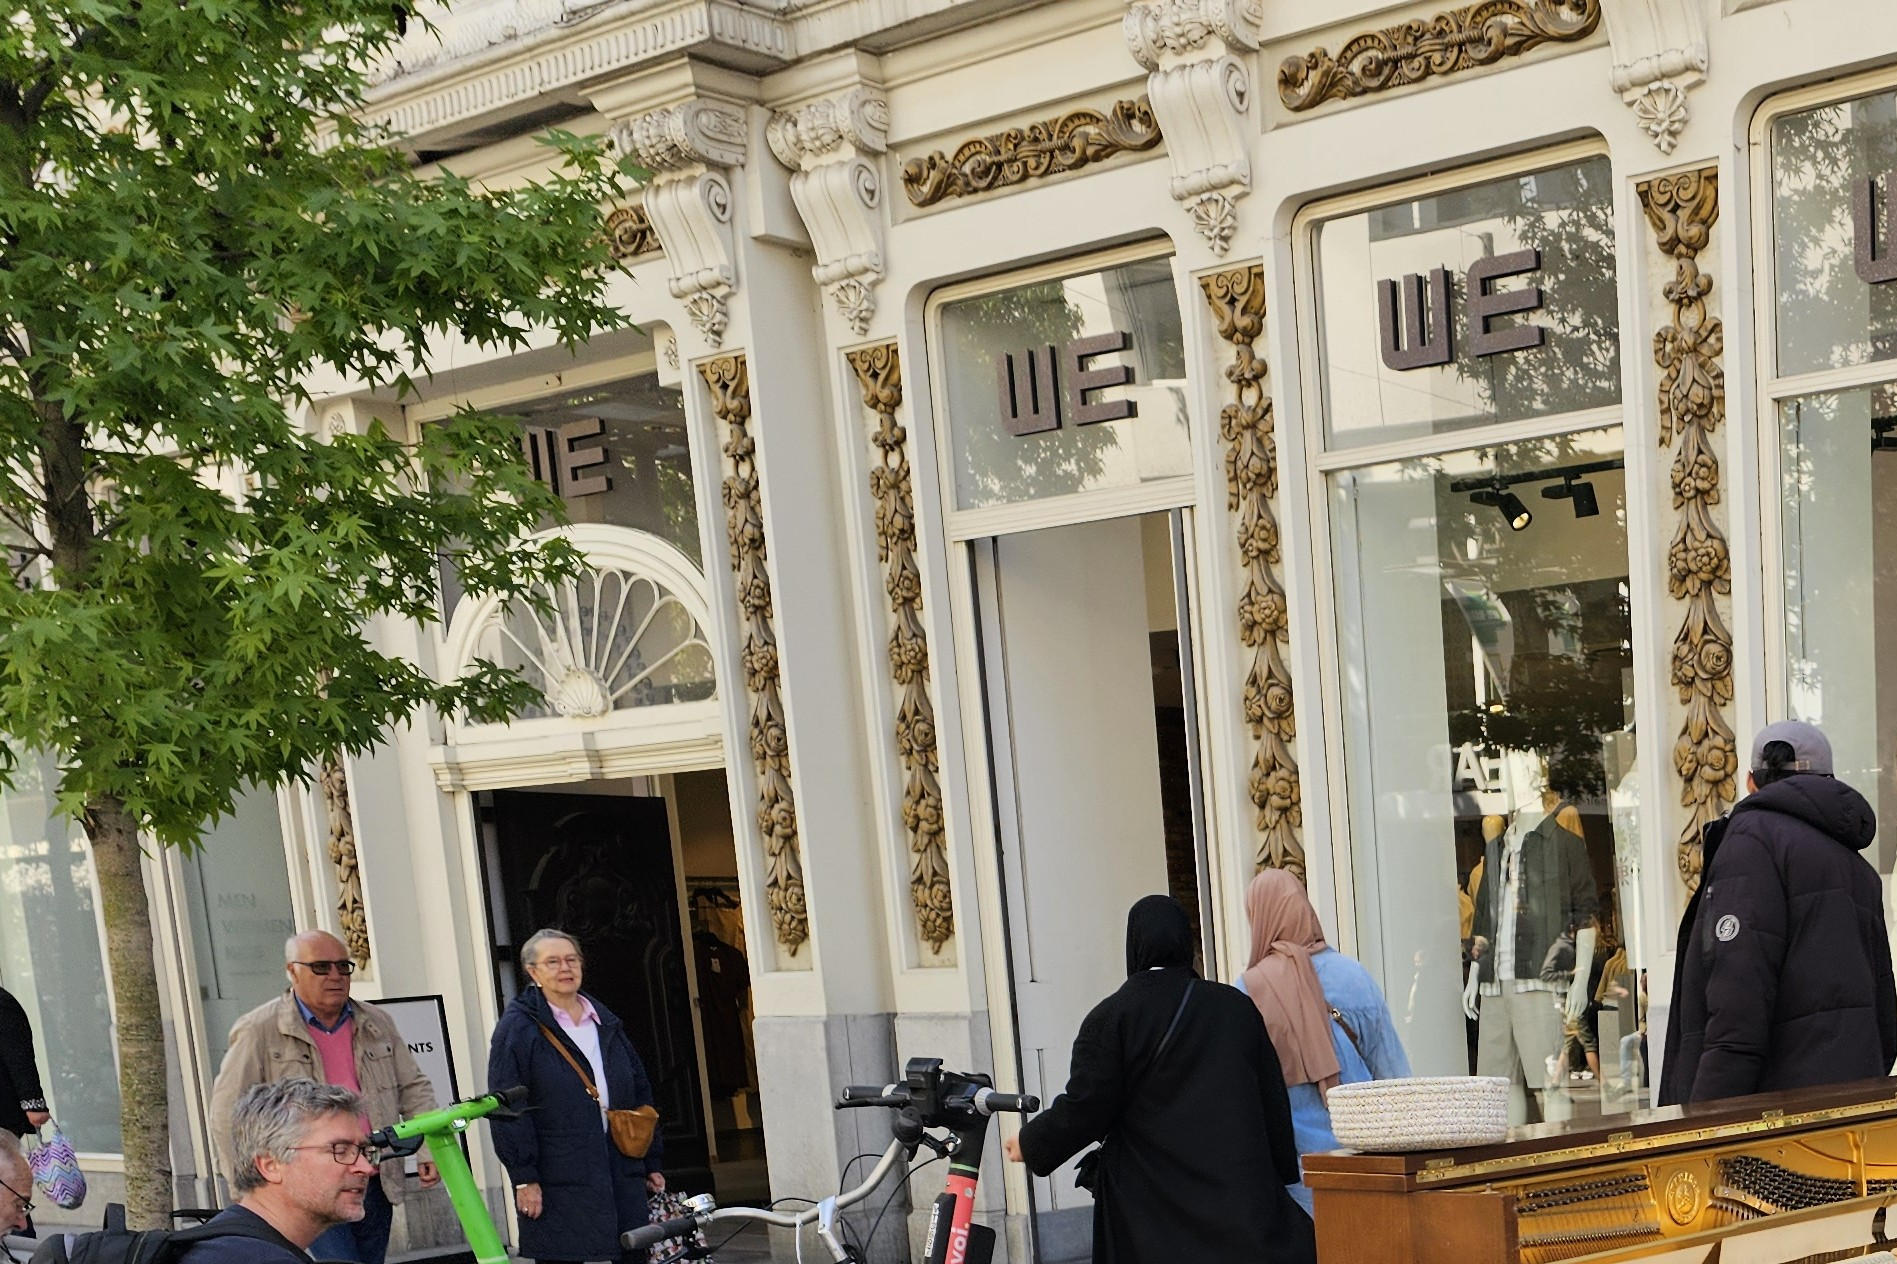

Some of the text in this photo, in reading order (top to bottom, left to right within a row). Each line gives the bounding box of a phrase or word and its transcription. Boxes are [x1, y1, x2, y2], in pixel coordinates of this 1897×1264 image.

[1378, 248, 1546, 372] WE
[997, 331, 1138, 437] WE
[408, 1042, 434, 1054] NTS
